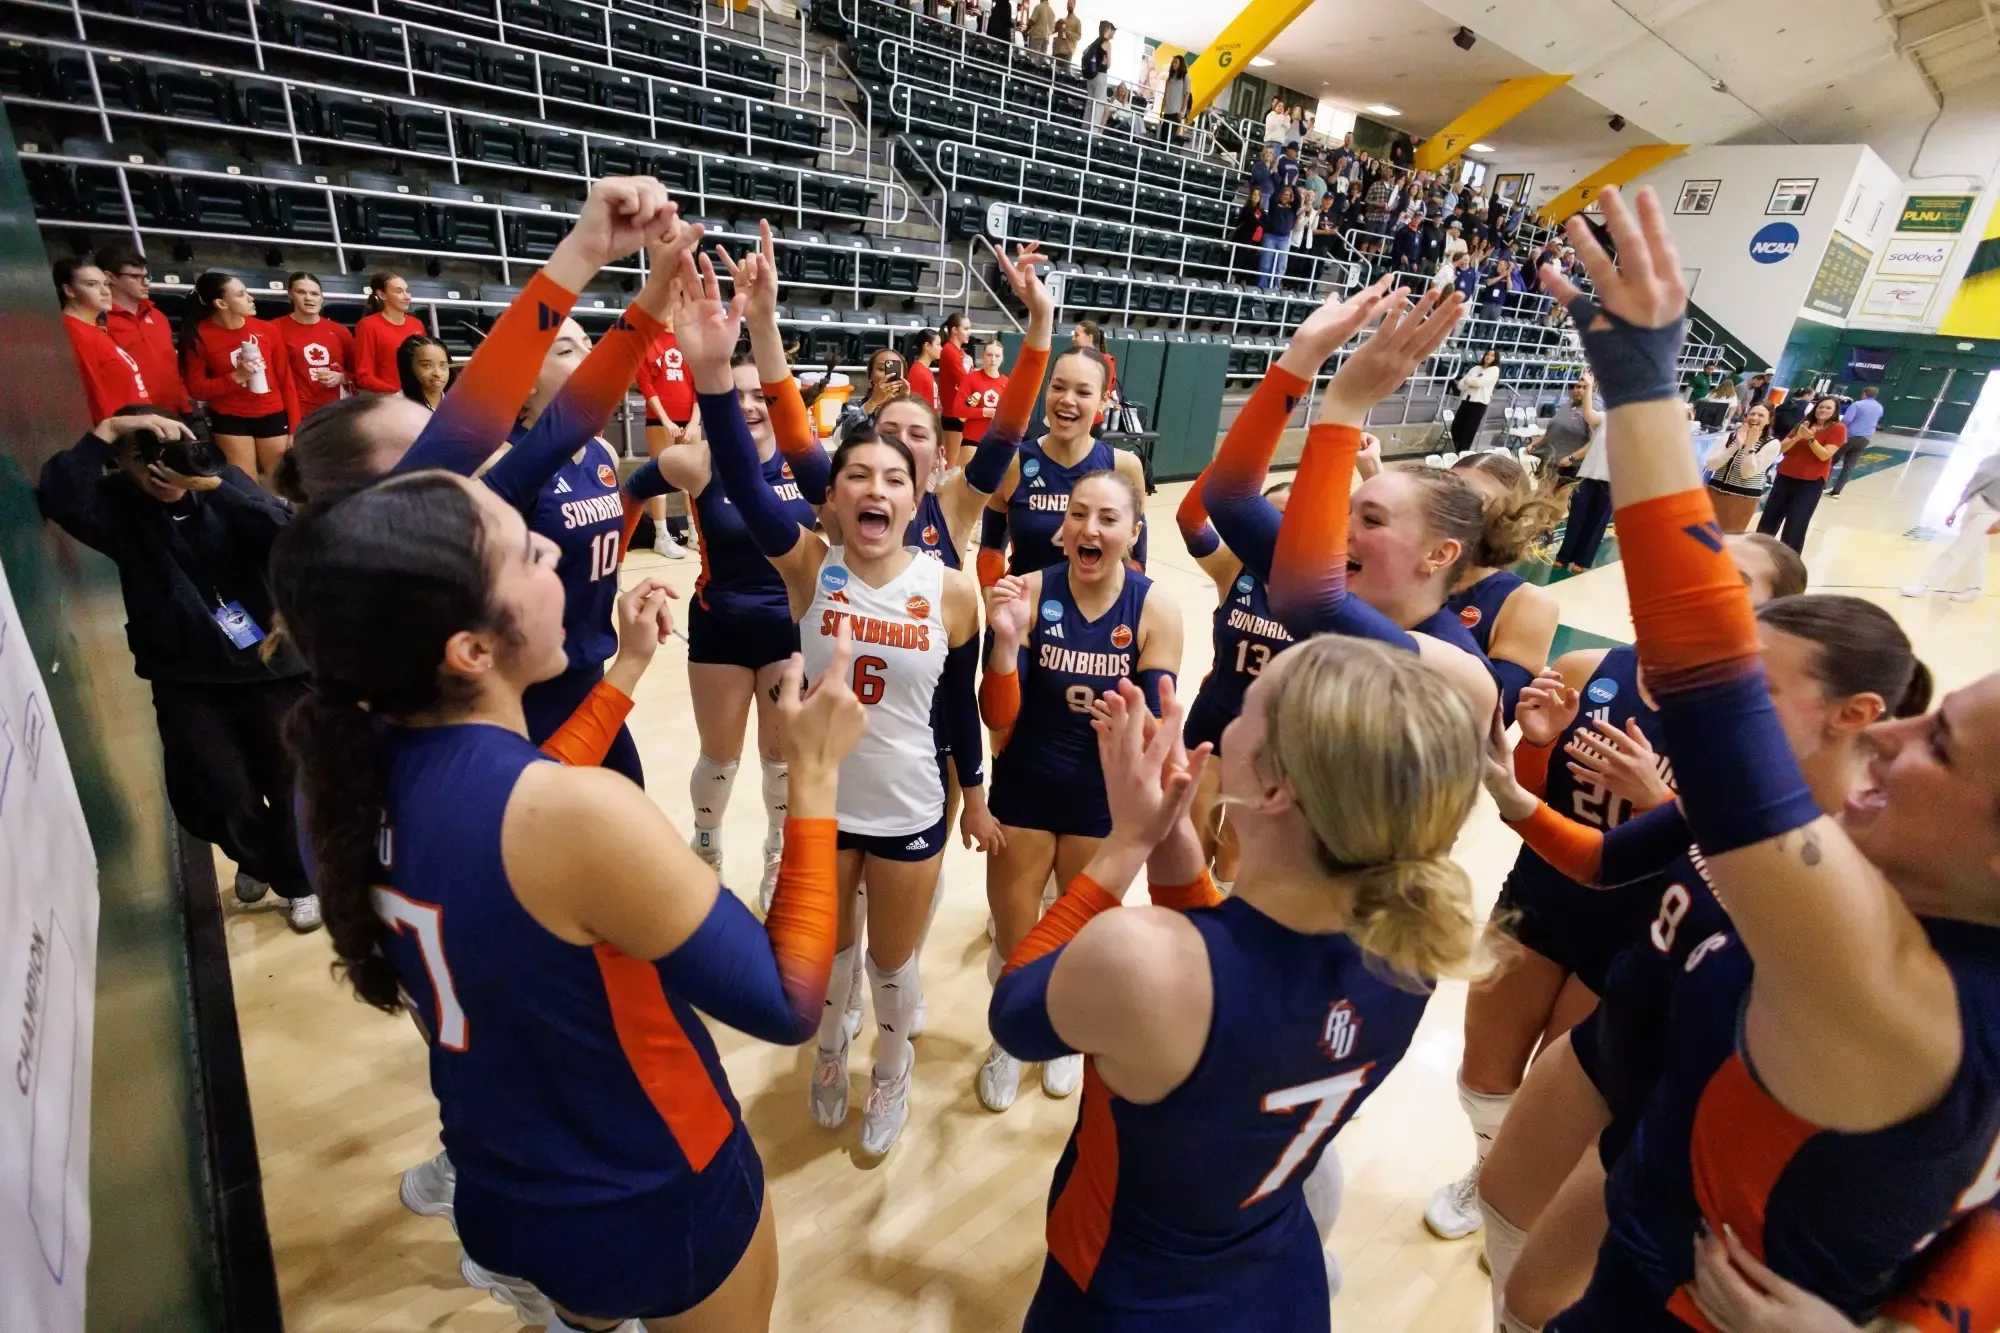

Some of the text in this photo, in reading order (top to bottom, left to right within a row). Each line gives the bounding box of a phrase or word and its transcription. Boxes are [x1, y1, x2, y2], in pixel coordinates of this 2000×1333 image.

[1218, 51, 1233, 67] G
[1446, 139, 1456, 150] F
[1581, 190, 1589, 199] E
[994, 218, 1000, 228] 2
[1902, 211, 1941, 221] PLNU
[1751, 242, 1796, 254] NCAA
[1888, 251, 1944, 263] sodexo
[1052, 286, 1056, 297] 1
[561, 491, 624, 530] SUNBIRD
[1029, 494, 1070, 512] SUNB
[588, 530, 620, 583] 10
[823, 574, 846, 586] NCAA
[1227, 608, 1294, 642] SUNBIRD
[1039, 643, 1131, 677] SUNBIRDS
[1236, 640, 1271, 676] 13
[853, 655, 888, 705] 6
[1064, 684, 1095, 714] 9
[1589, 686, 1613, 700] NCAA
[1649, 882, 1692, 953] 8
[373, 884, 469, 1053] 7
[16, 921, 45, 1096] CHAMPION
[1239, 1060, 1376, 1209] 7
